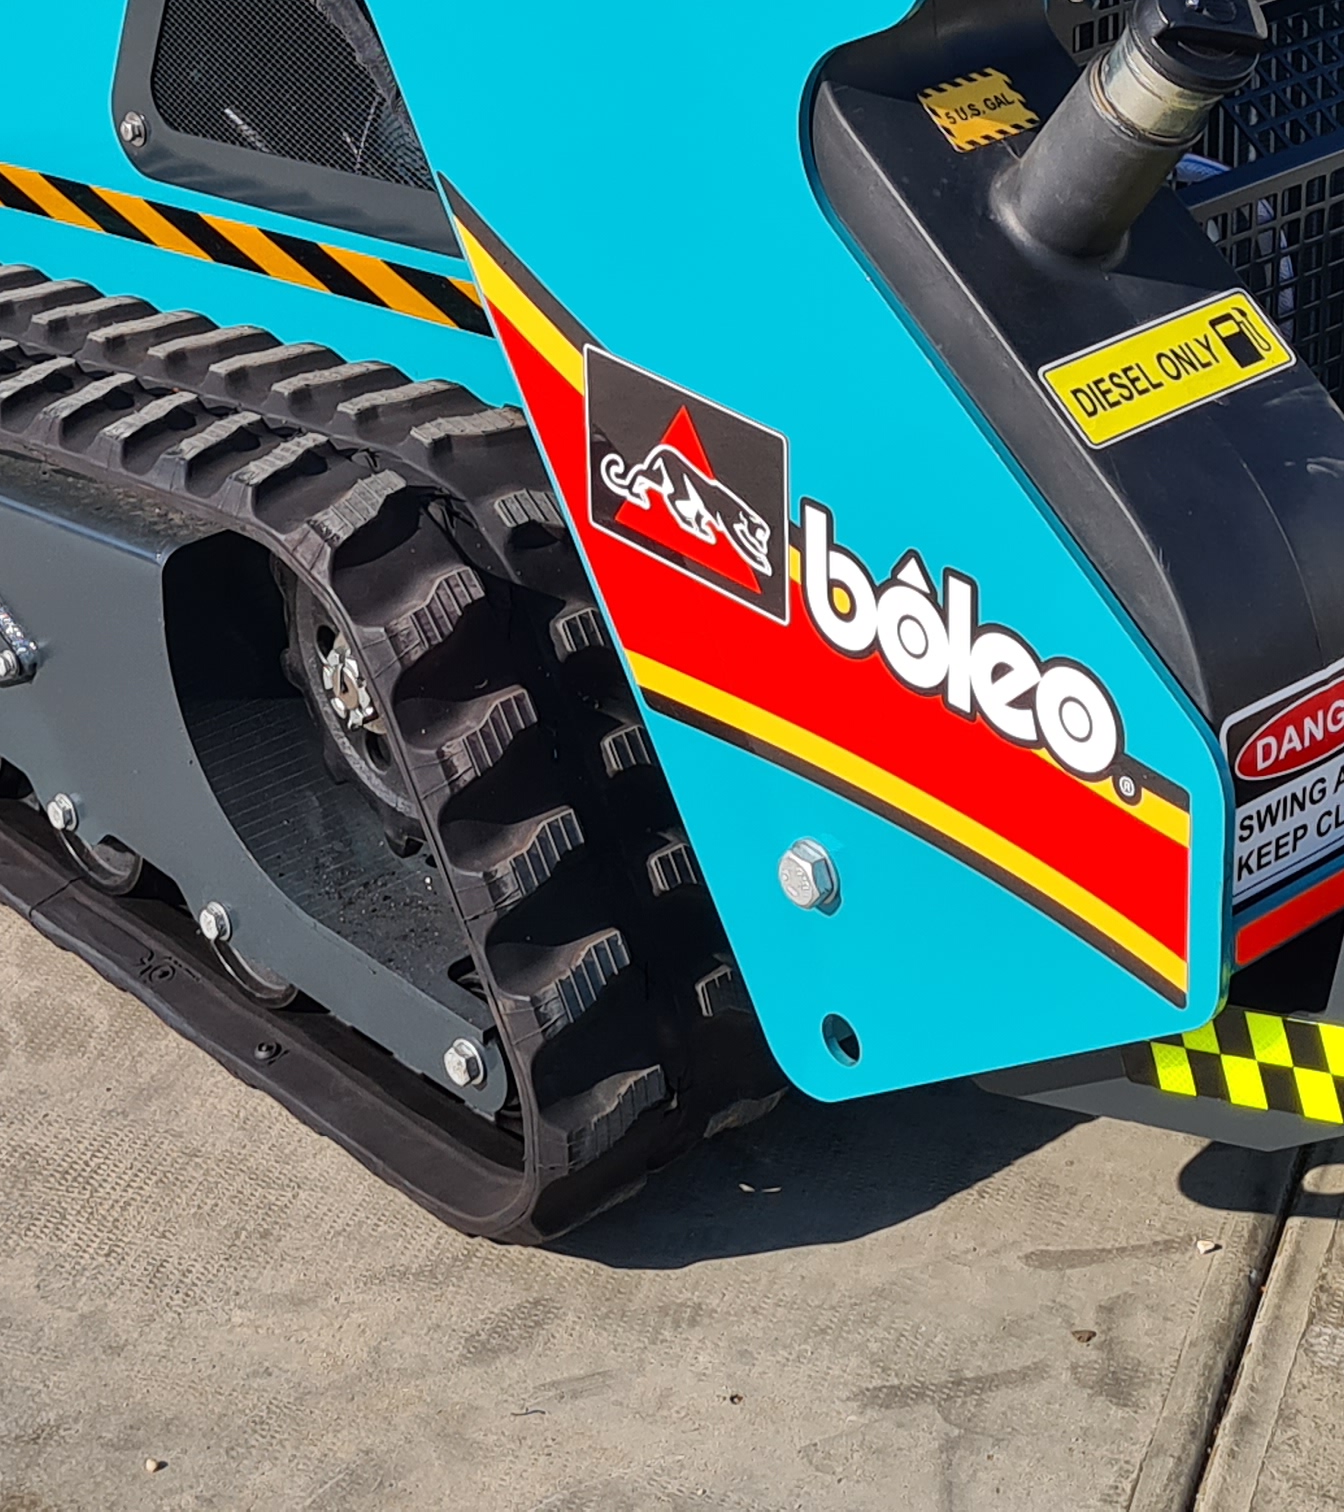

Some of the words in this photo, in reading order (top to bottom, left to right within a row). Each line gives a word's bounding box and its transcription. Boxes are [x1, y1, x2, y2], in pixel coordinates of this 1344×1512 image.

[945, 111, 957, 125] 5
[983, 93, 1015, 110] GAL
[1070, 363, 1164, 418] DIESEL
[1156, 334, 1220, 381] ONLY
[801, 498, 1123, 780] bôleo
[1238, 777, 1327, 844] SWING
[1237, 826, 1309, 882] KEEP
